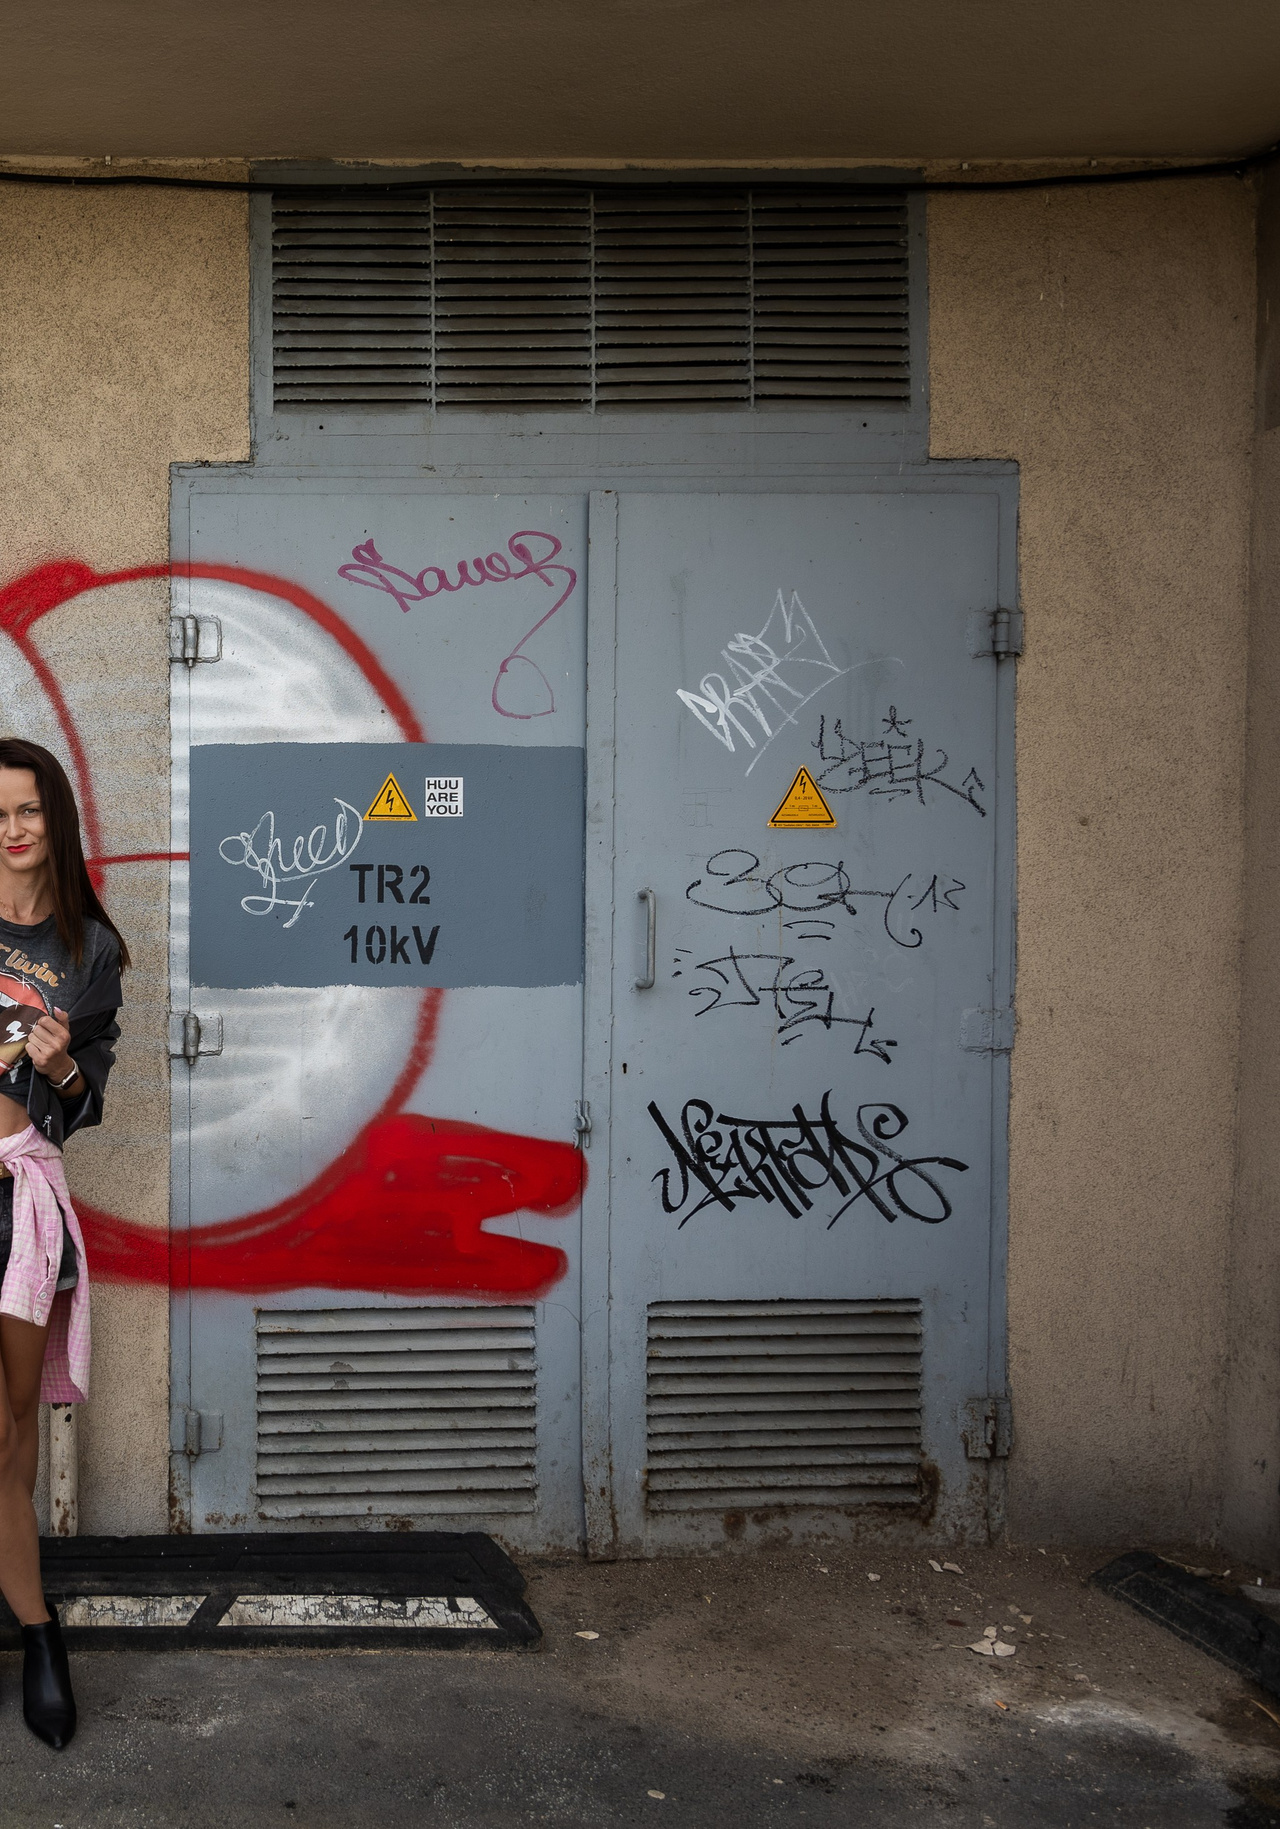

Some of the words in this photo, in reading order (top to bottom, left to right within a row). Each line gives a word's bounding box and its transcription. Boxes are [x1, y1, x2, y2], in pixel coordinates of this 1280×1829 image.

[427, 779, 459, 790] HUU
[426, 792, 459, 802] ARE
[426, 804, 462, 815] YOU.
[349, 864, 431, 904] TR2
[343, 925, 441, 965] 10kV
